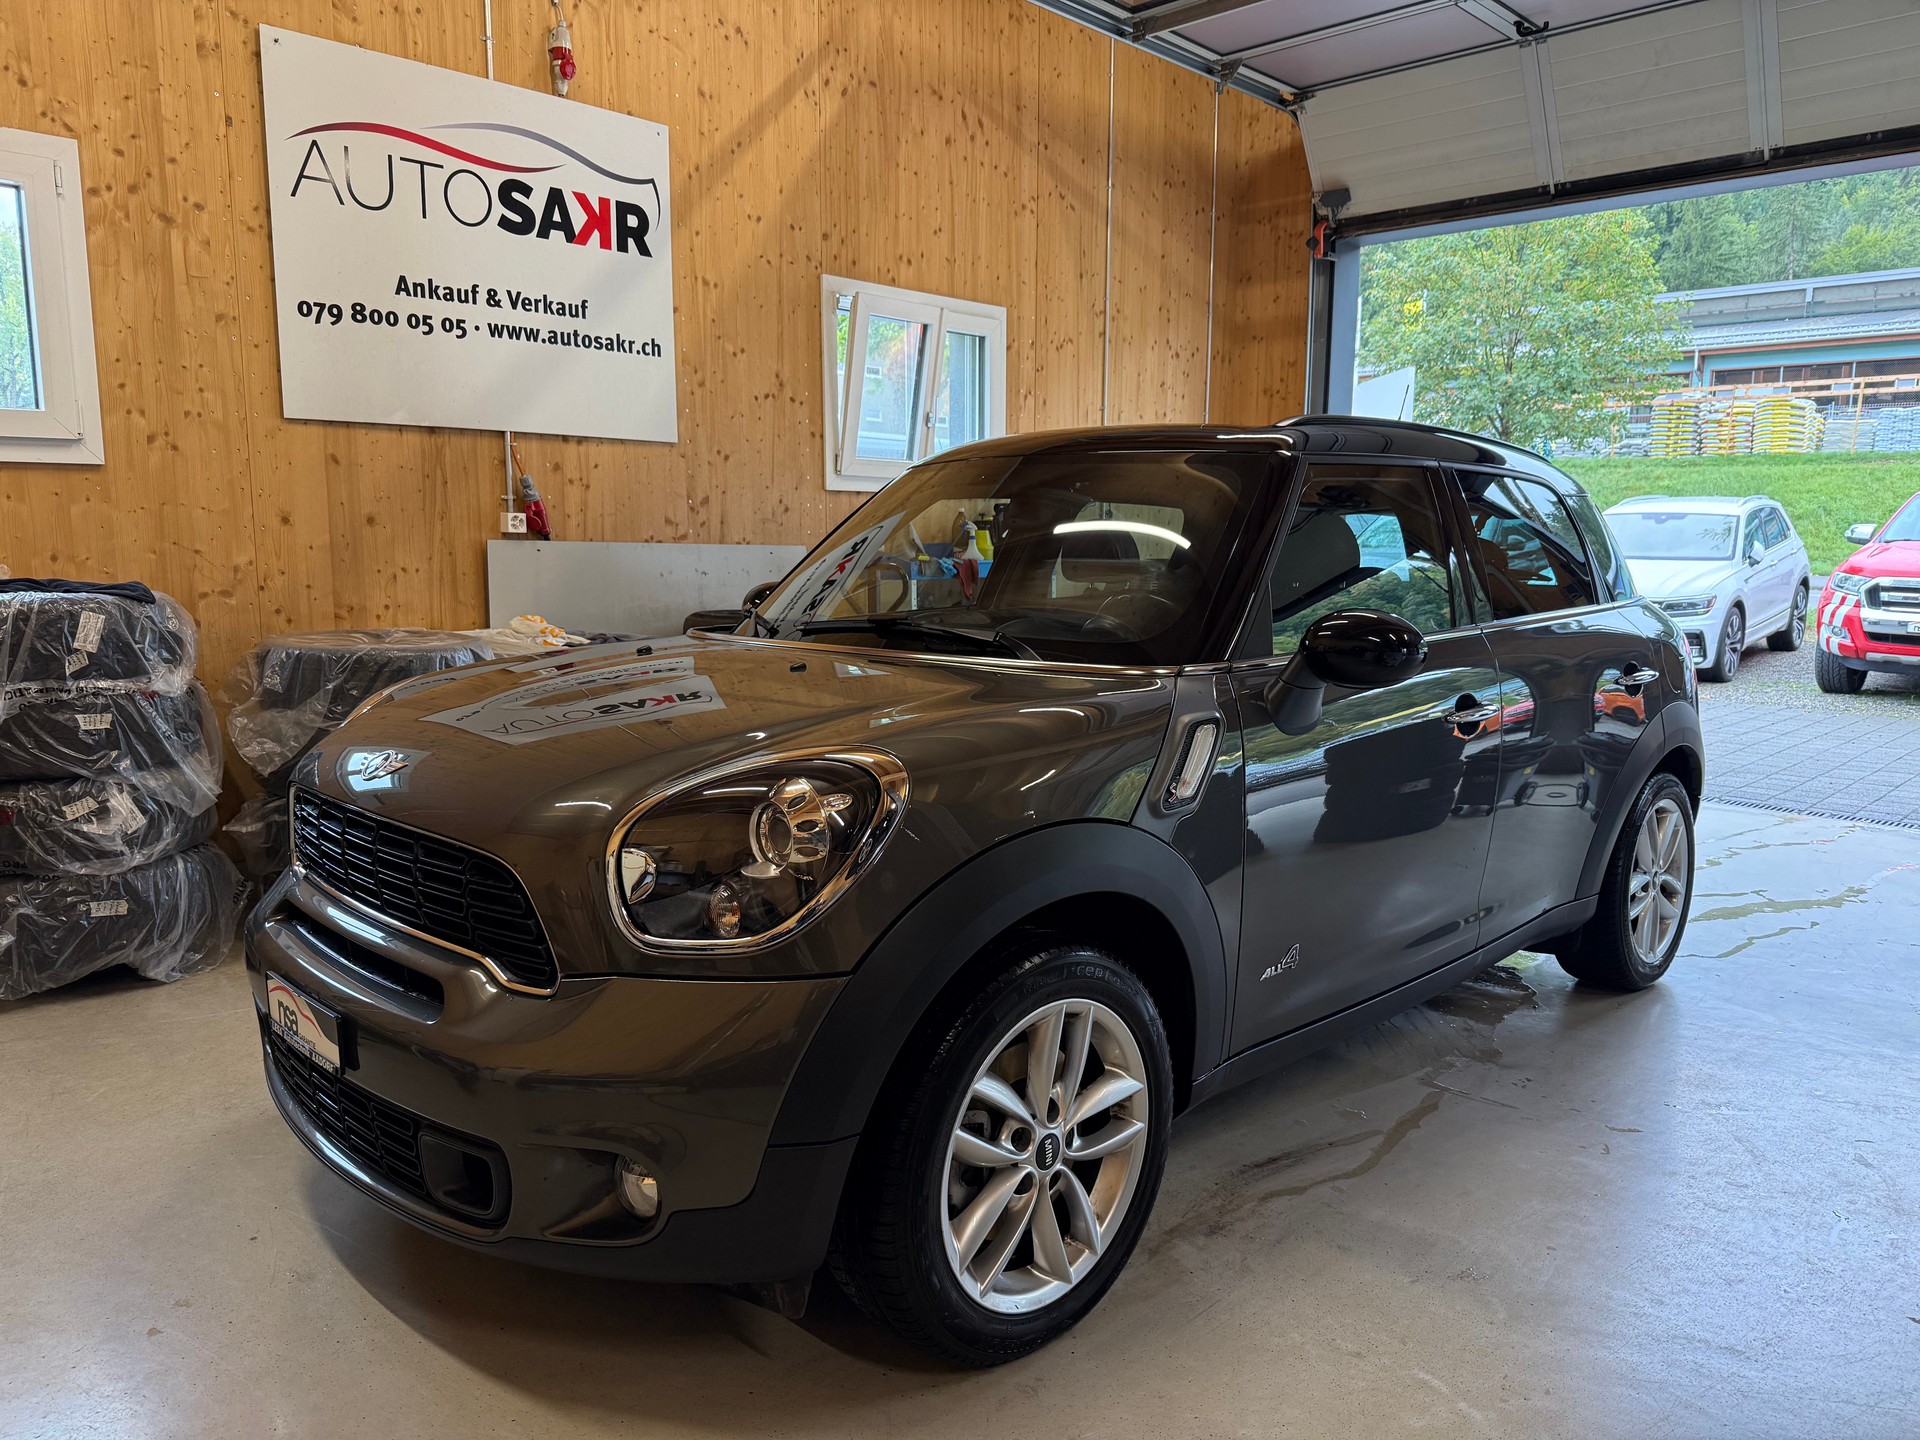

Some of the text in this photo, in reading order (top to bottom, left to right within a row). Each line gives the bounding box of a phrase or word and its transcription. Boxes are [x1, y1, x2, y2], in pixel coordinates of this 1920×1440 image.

[290, 139, 653, 258] AUTOSAKR
[395, 275, 588, 320] Ankauf & Verkauf
[297, 300, 662, 357] 079 800 05 05 www.autosakr.ch
[277, 999, 299, 1036] nsa
[1044, 1138, 1053, 1166] MINI
